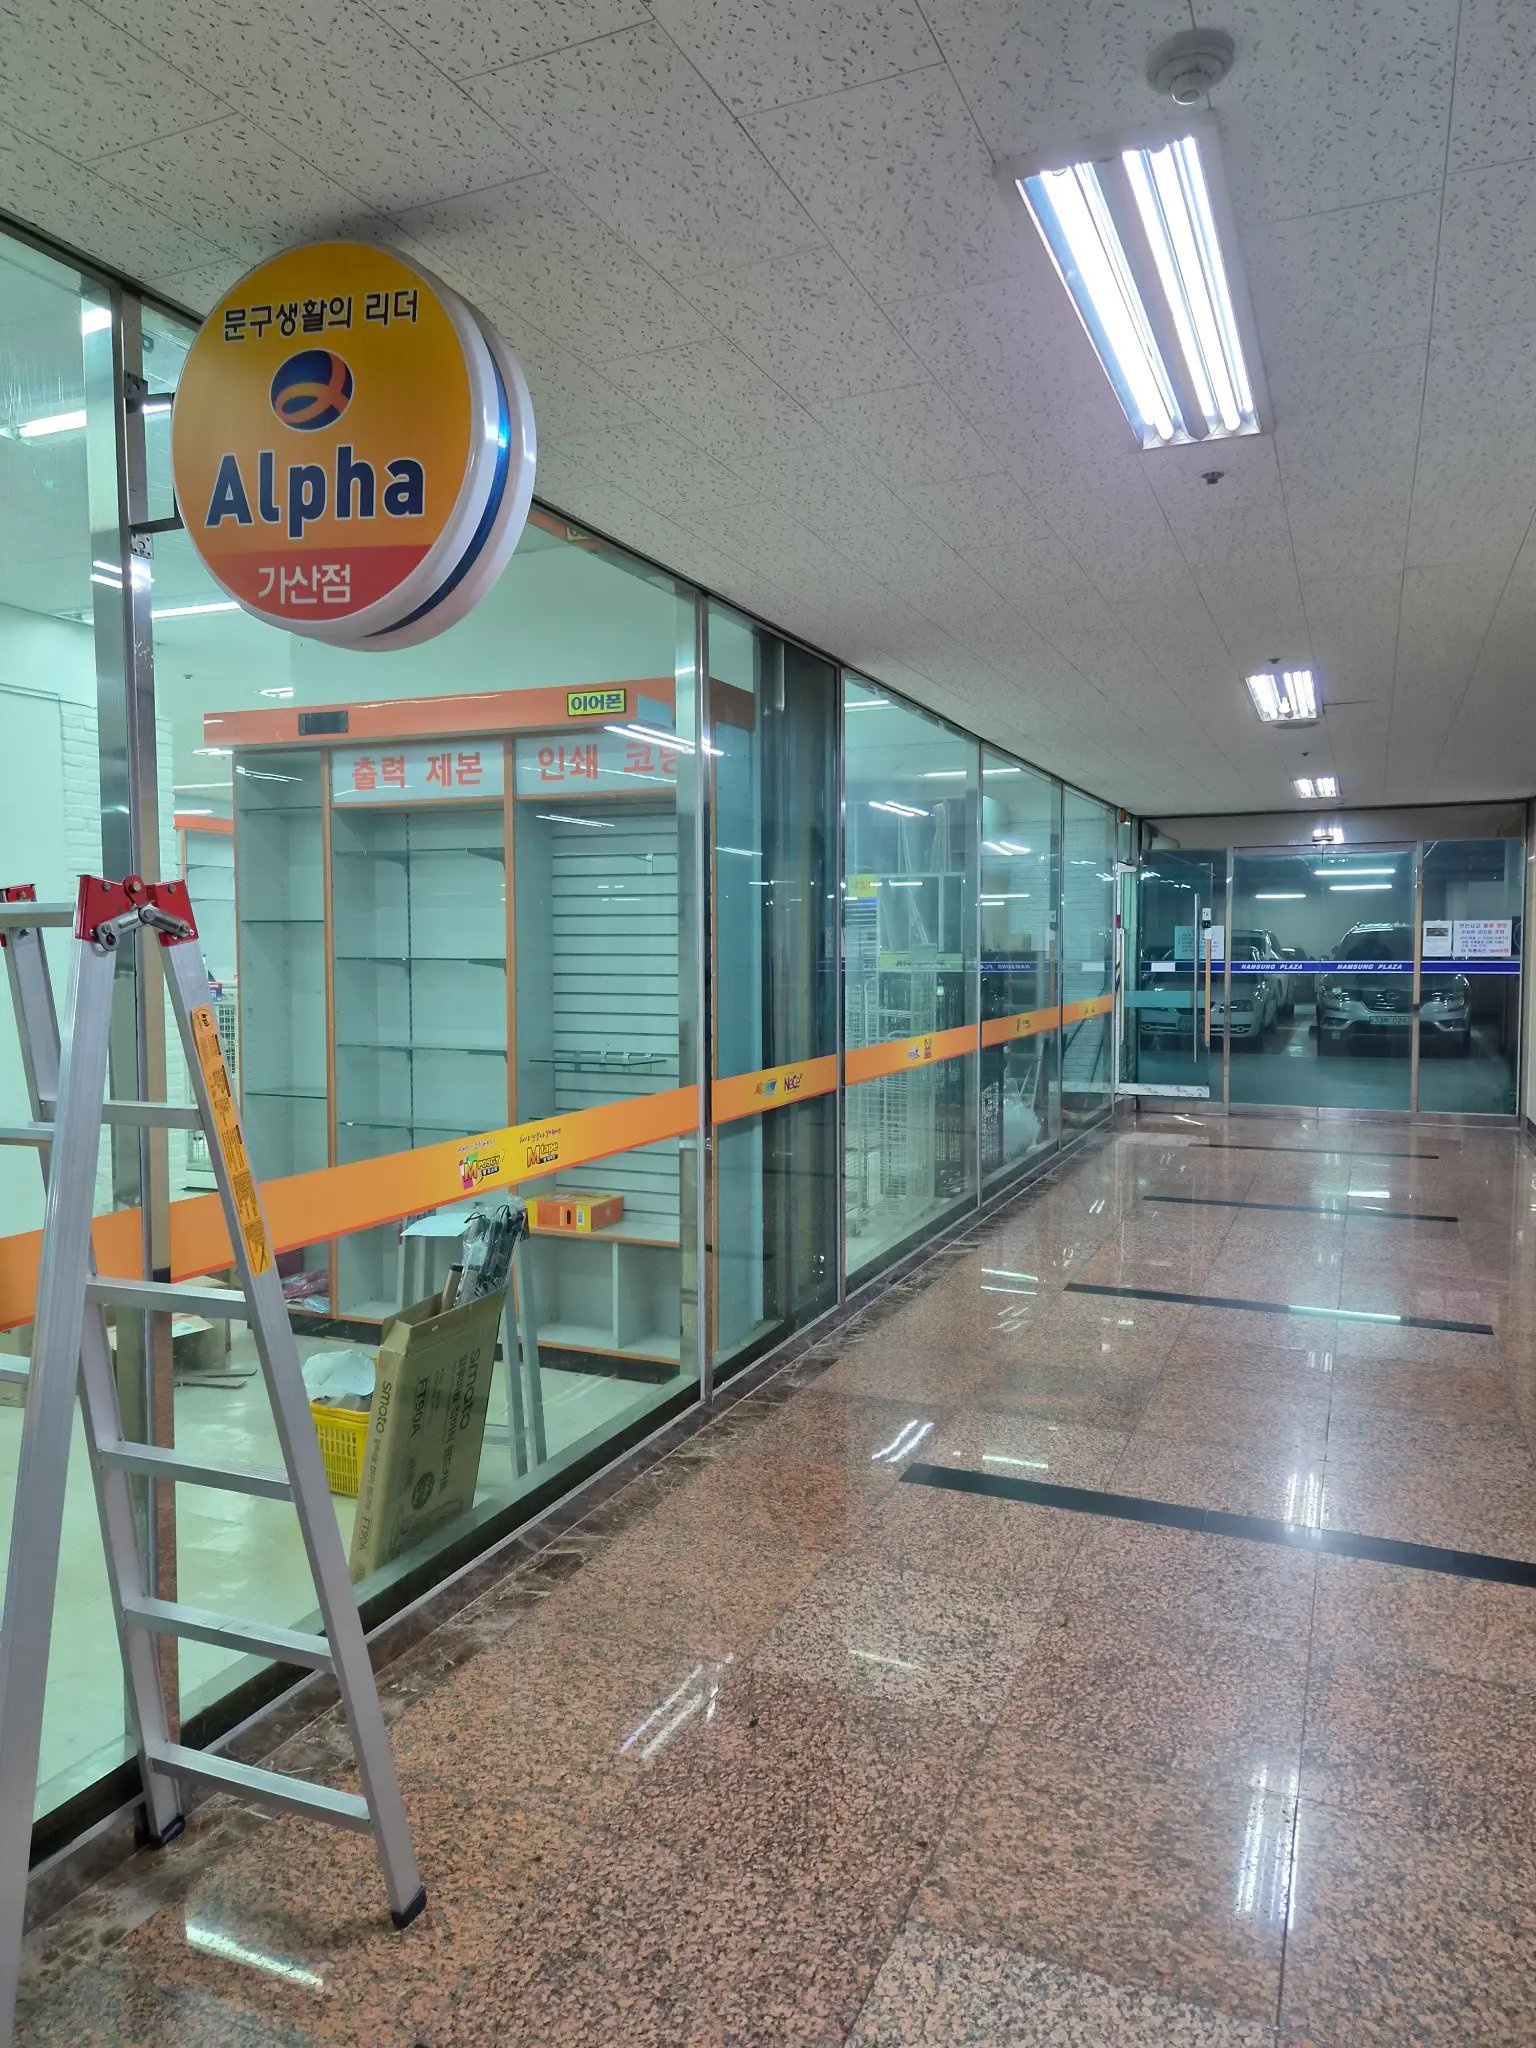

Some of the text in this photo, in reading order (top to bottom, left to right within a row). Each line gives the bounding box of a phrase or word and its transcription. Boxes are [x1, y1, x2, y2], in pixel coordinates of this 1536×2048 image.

[224, 288, 420, 342] 문구생활의 리더
[204, 444, 426, 540] Alpha
[257, 563, 351, 605] 가산점
[570, 692, 623, 713] 이어폰
[352, 752, 484, 790] 출력 제본
[537, 743, 598, 781] 인쇄
[376, 1380, 392, 1434] smato
[411, 1376, 429, 1438] FT90A
[459, 1348, 481, 1430] smato
[359, 1516, 371, 1551] FT90A
